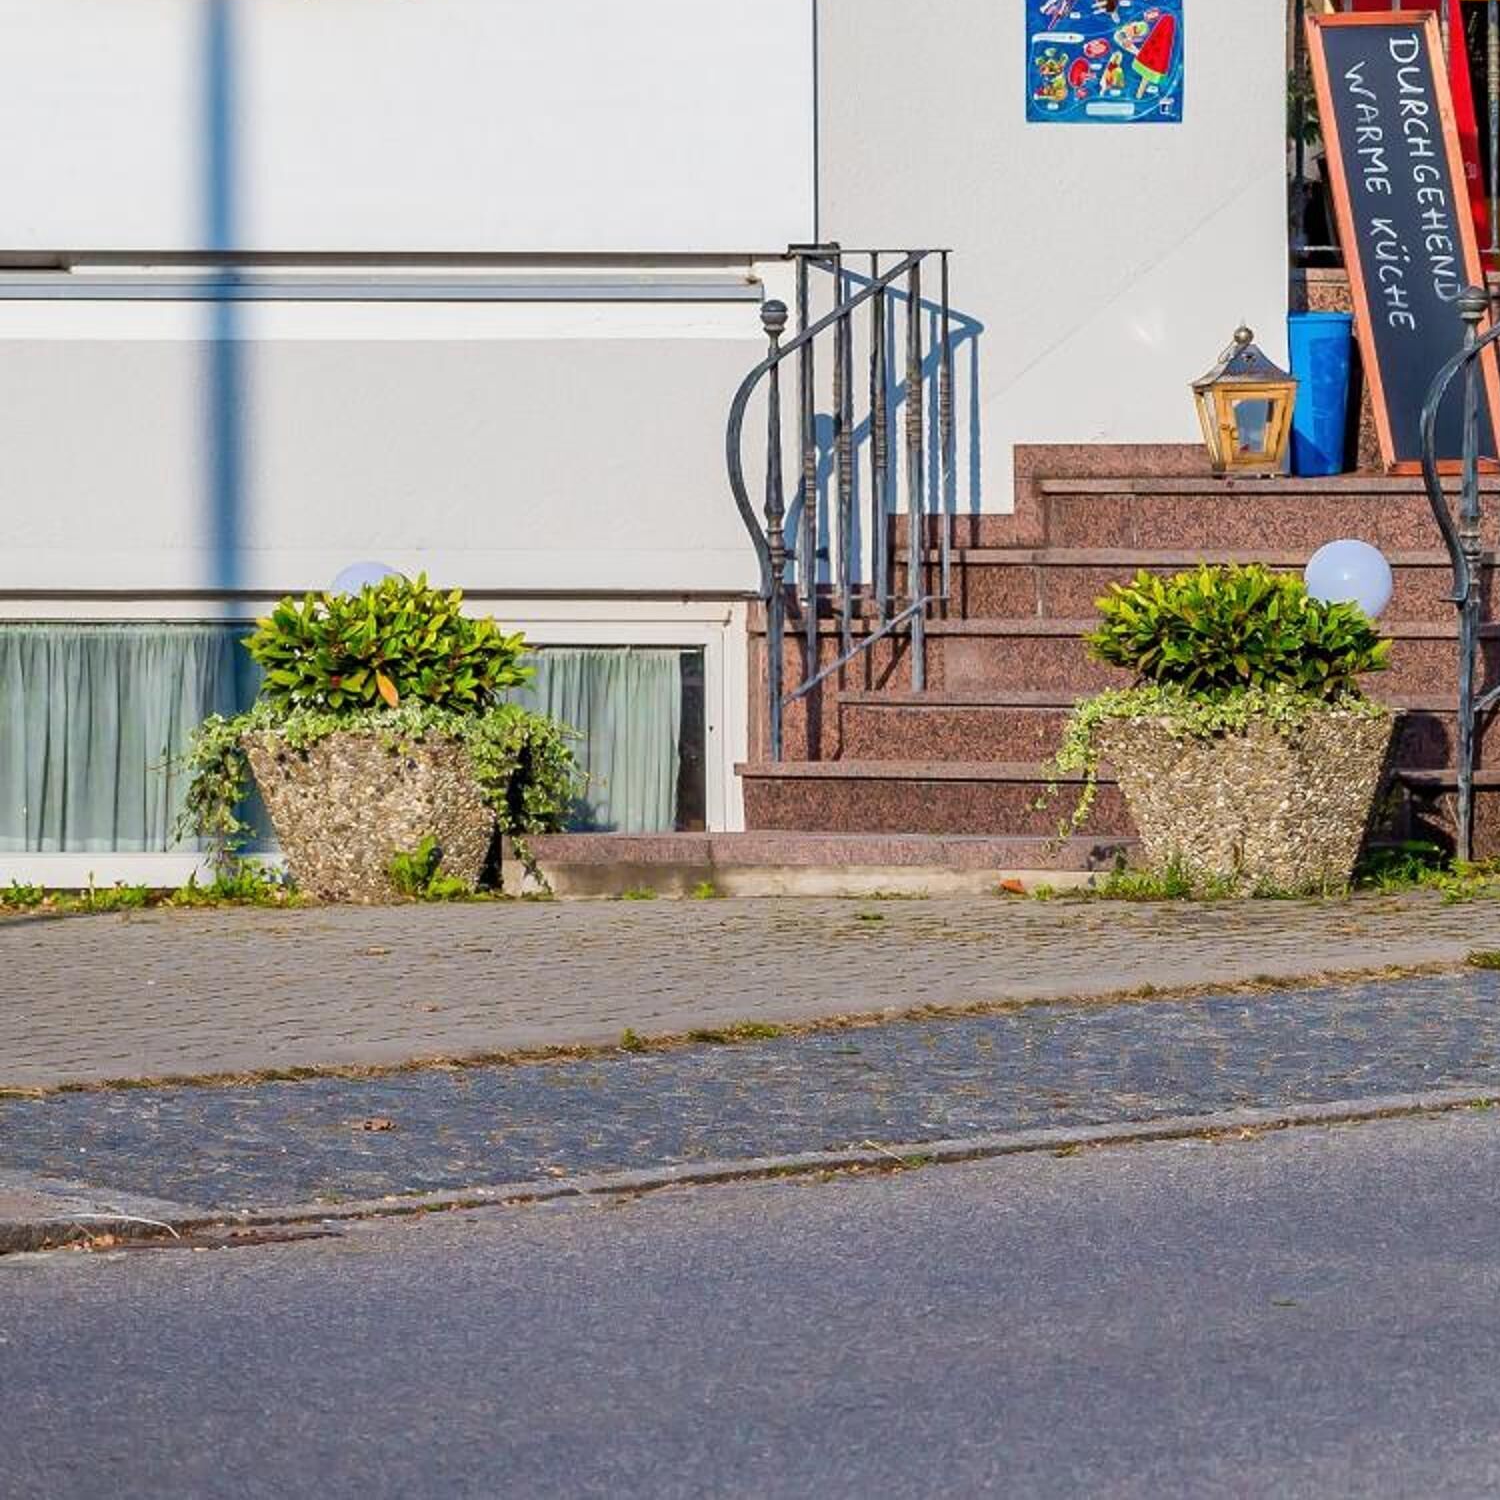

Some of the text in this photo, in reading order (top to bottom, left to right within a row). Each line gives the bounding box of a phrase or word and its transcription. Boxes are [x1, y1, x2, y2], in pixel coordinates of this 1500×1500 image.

[1345, 60, 1416, 331] WARME KÜCHE
[1389, 33, 1465, 302] DURCHGEHEND
